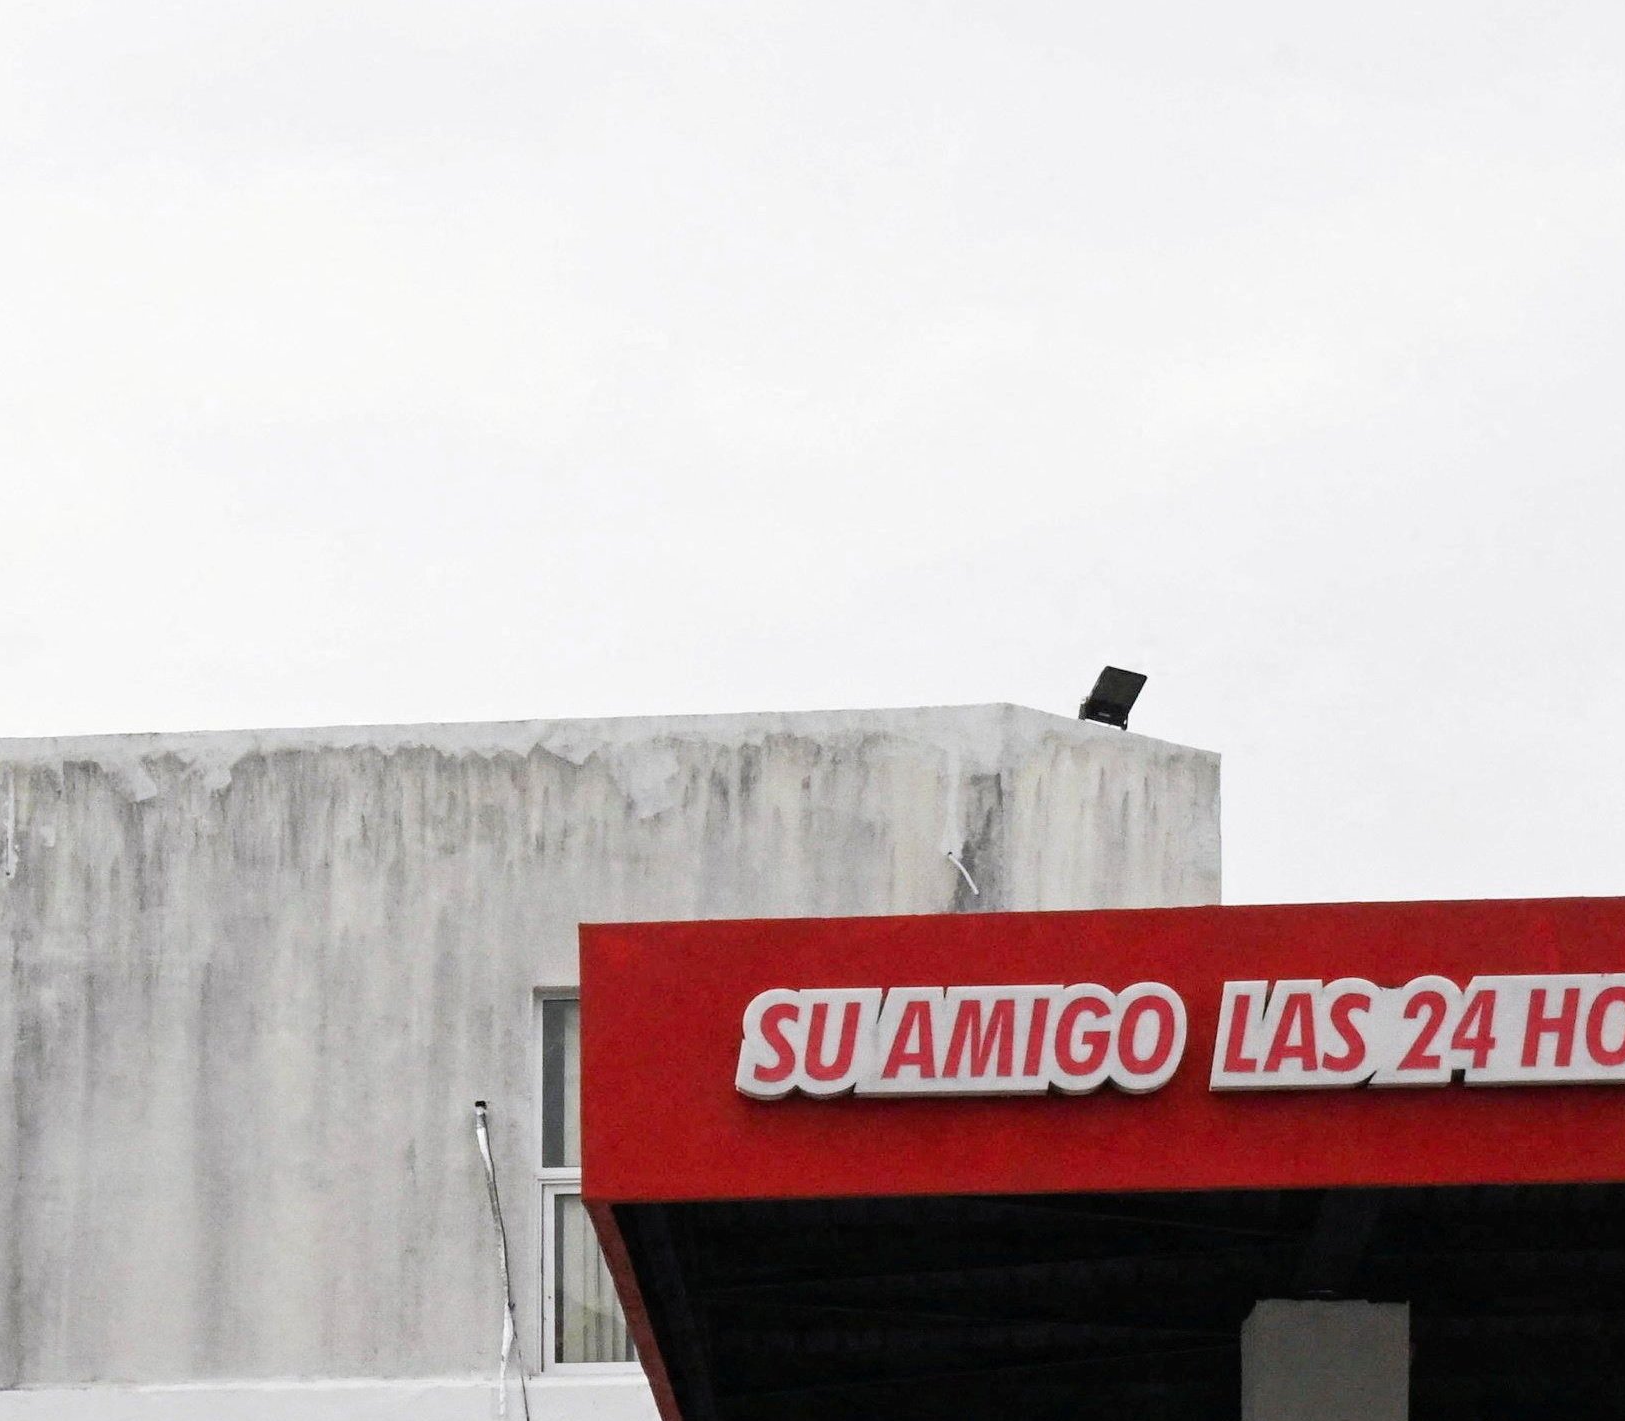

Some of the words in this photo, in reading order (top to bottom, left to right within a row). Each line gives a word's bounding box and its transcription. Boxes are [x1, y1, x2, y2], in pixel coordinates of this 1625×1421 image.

[753, 1001, 862, 1083] SU
[882, 994, 1177, 1079] AMIGO
[1223, 992, 1372, 1074] LAS
[1398, 989, 1498, 1071] 24
